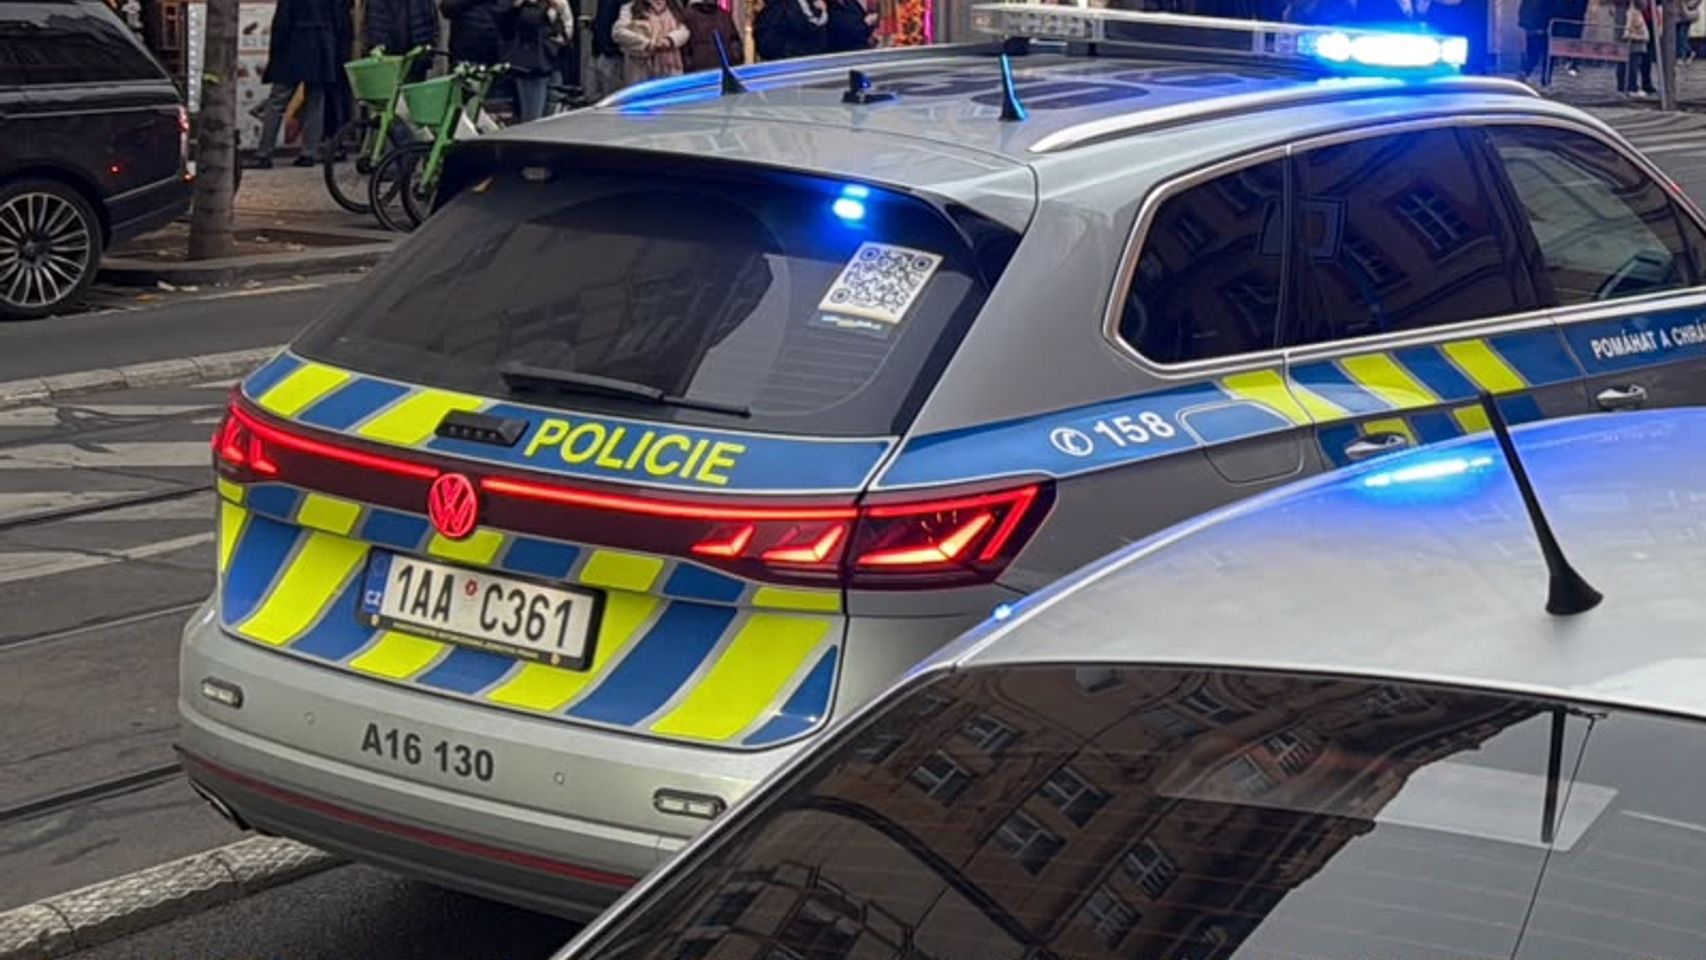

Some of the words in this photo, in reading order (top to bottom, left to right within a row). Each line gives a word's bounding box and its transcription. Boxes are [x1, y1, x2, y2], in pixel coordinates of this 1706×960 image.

[1590, 328, 1657, 360] POMÁHAT
[1659, 328, 1672, 349] A
[523, 418, 747, 486] POLICIE
[1093, 411, 1176, 448] 158
[364, 590, 383, 607] CZ
[397, 564, 455, 623] 1AA
[480, 583, 573, 649] C361
[361, 722, 422, 765] A16
[434, 740, 495, 783] 130
